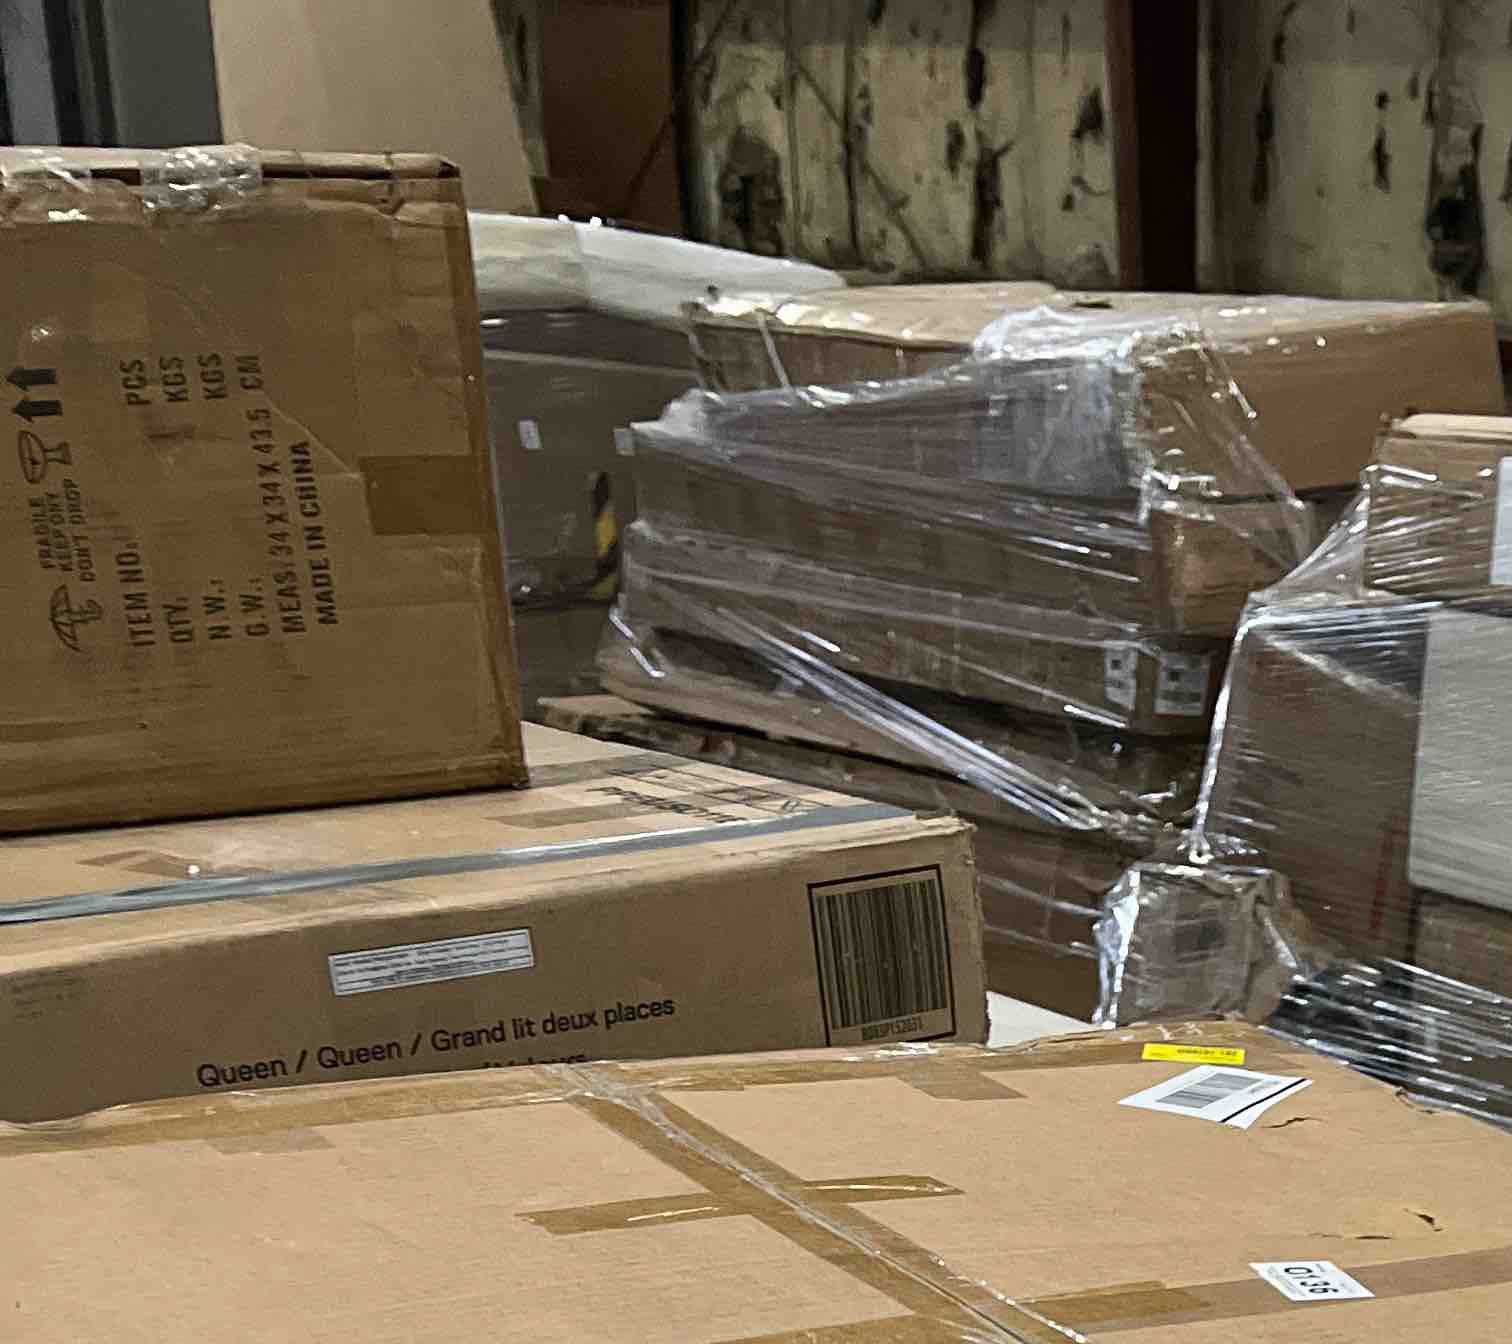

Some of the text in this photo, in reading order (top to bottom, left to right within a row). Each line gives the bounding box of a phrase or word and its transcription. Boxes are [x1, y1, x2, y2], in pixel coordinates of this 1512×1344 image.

[119, 359, 150, 406] PCS
[160, 357, 188, 403] KGS
[198, 353, 227, 399] KGS
[237, 355, 264, 391] CM
[288, 441, 338, 624] MADE IN CHINA
[122, 592, 156, 647] ITEM
[196, 999, 674, 1087] Queen / Queen / Grand lit deux places
